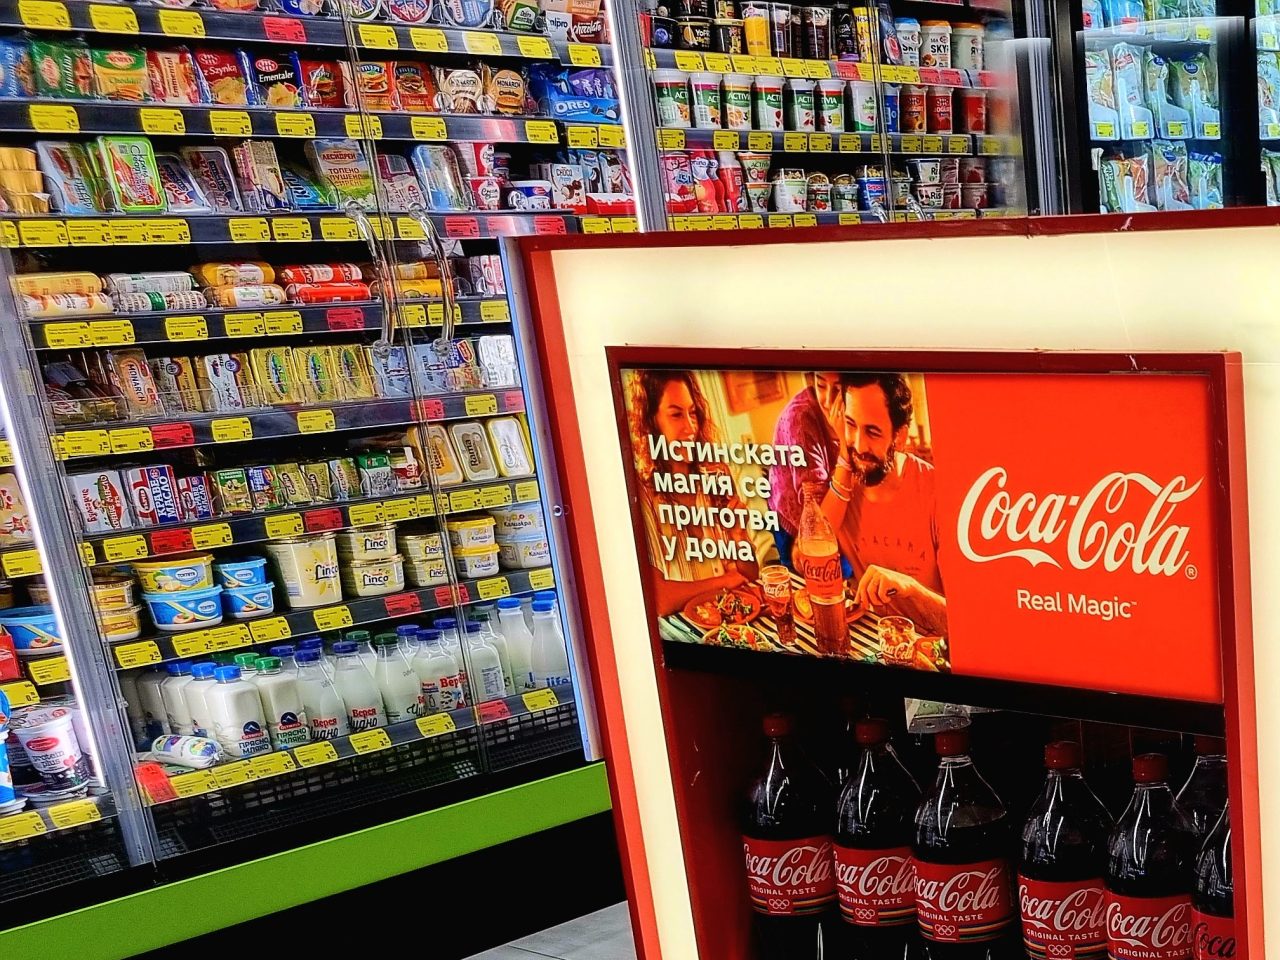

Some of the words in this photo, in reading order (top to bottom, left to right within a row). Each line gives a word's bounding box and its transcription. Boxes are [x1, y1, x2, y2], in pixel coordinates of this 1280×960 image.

[258, 71, 294, 83] Ementaler
[798, 96, 813, 104] ACTI
[821, 96, 837, 104] TIVIA
[555, 101, 590, 113] OREO
[128, 364, 147, 402] MONARCH
[467, 439, 475, 466] Rama
[649, 433, 807, 467] Истинската
[653, 472, 734, 499] магия
[743, 476, 772, 499] се
[150, 480, 167, 517] КРАВЕ
[159, 475, 177, 518] МАСЛО
[199, 484, 210, 512] МАСЛО
[659, 503, 780, 534] приготвя
[957, 466, 1204, 578] Coca-Cola
[664, 535, 677, 560] у
[685, 536, 754, 564] дома
[804, 558, 841, 583] Coca-Cola
[1016, 588, 1062, 613] Real
[440, 676, 460, 688] Вер
[352, 708, 376, 718] Верея
[313, 718, 337, 729] Верея
[277, 728, 306, 740] ПРЯСНО
[280, 735, 306, 745] МЛЯКО
[238, 737, 269, 749] ПРЯСНО
[242, 744, 269, 753] МЛЯКО
[32, 750, 64, 762] protein
[42, 759, 60, 768] plus
[785, 887, 817, 896] TASTE
[872, 897, 903, 906] TASTE
[952, 913, 984, 922] TASTE
[1026, 928, 1065, 941] ORIGINAL
[1067, 931, 1100, 941] TASTE
[1117, 947, 1162, 958] ORIGINAL
